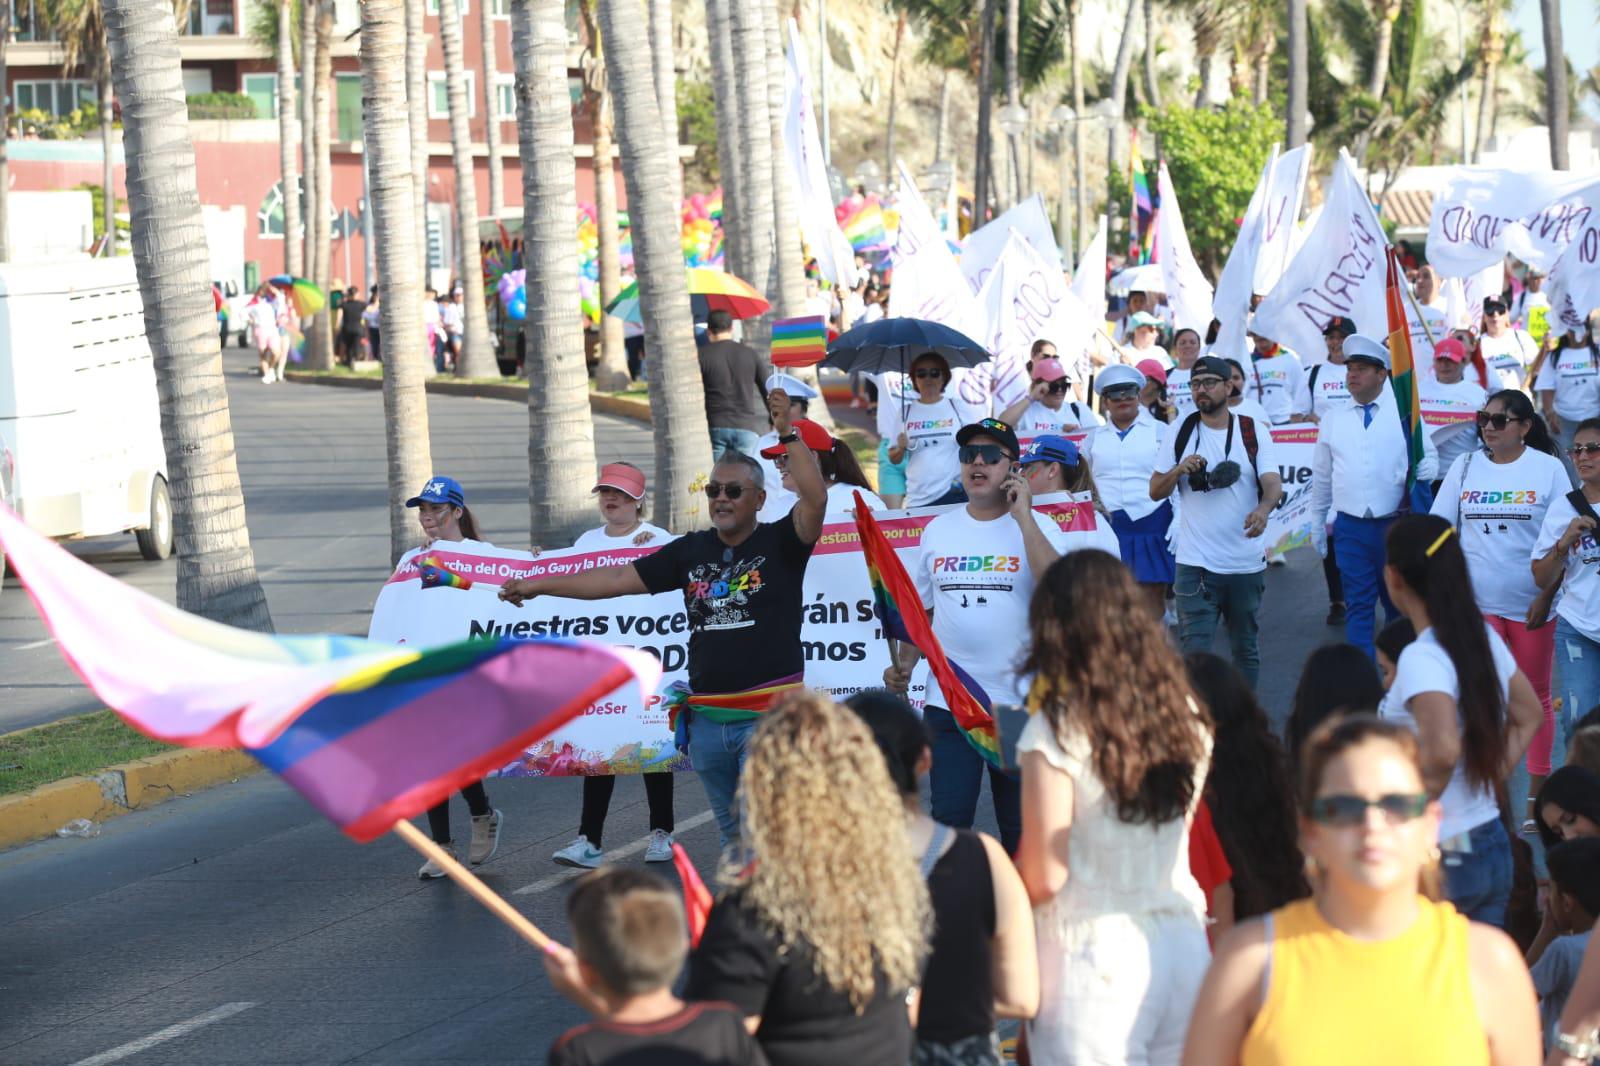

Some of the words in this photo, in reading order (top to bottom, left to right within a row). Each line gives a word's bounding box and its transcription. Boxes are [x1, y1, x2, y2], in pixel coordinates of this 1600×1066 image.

[475, 562, 496, 575] del
[498, 564, 545, 580] Orgullo
[547, 561, 573, 574] Gay
[574, 561, 582, 576] y
[583, 558, 594, 570] la
[468, 616, 609, 640] Nuestras
[616, 612, 688, 636] voce
